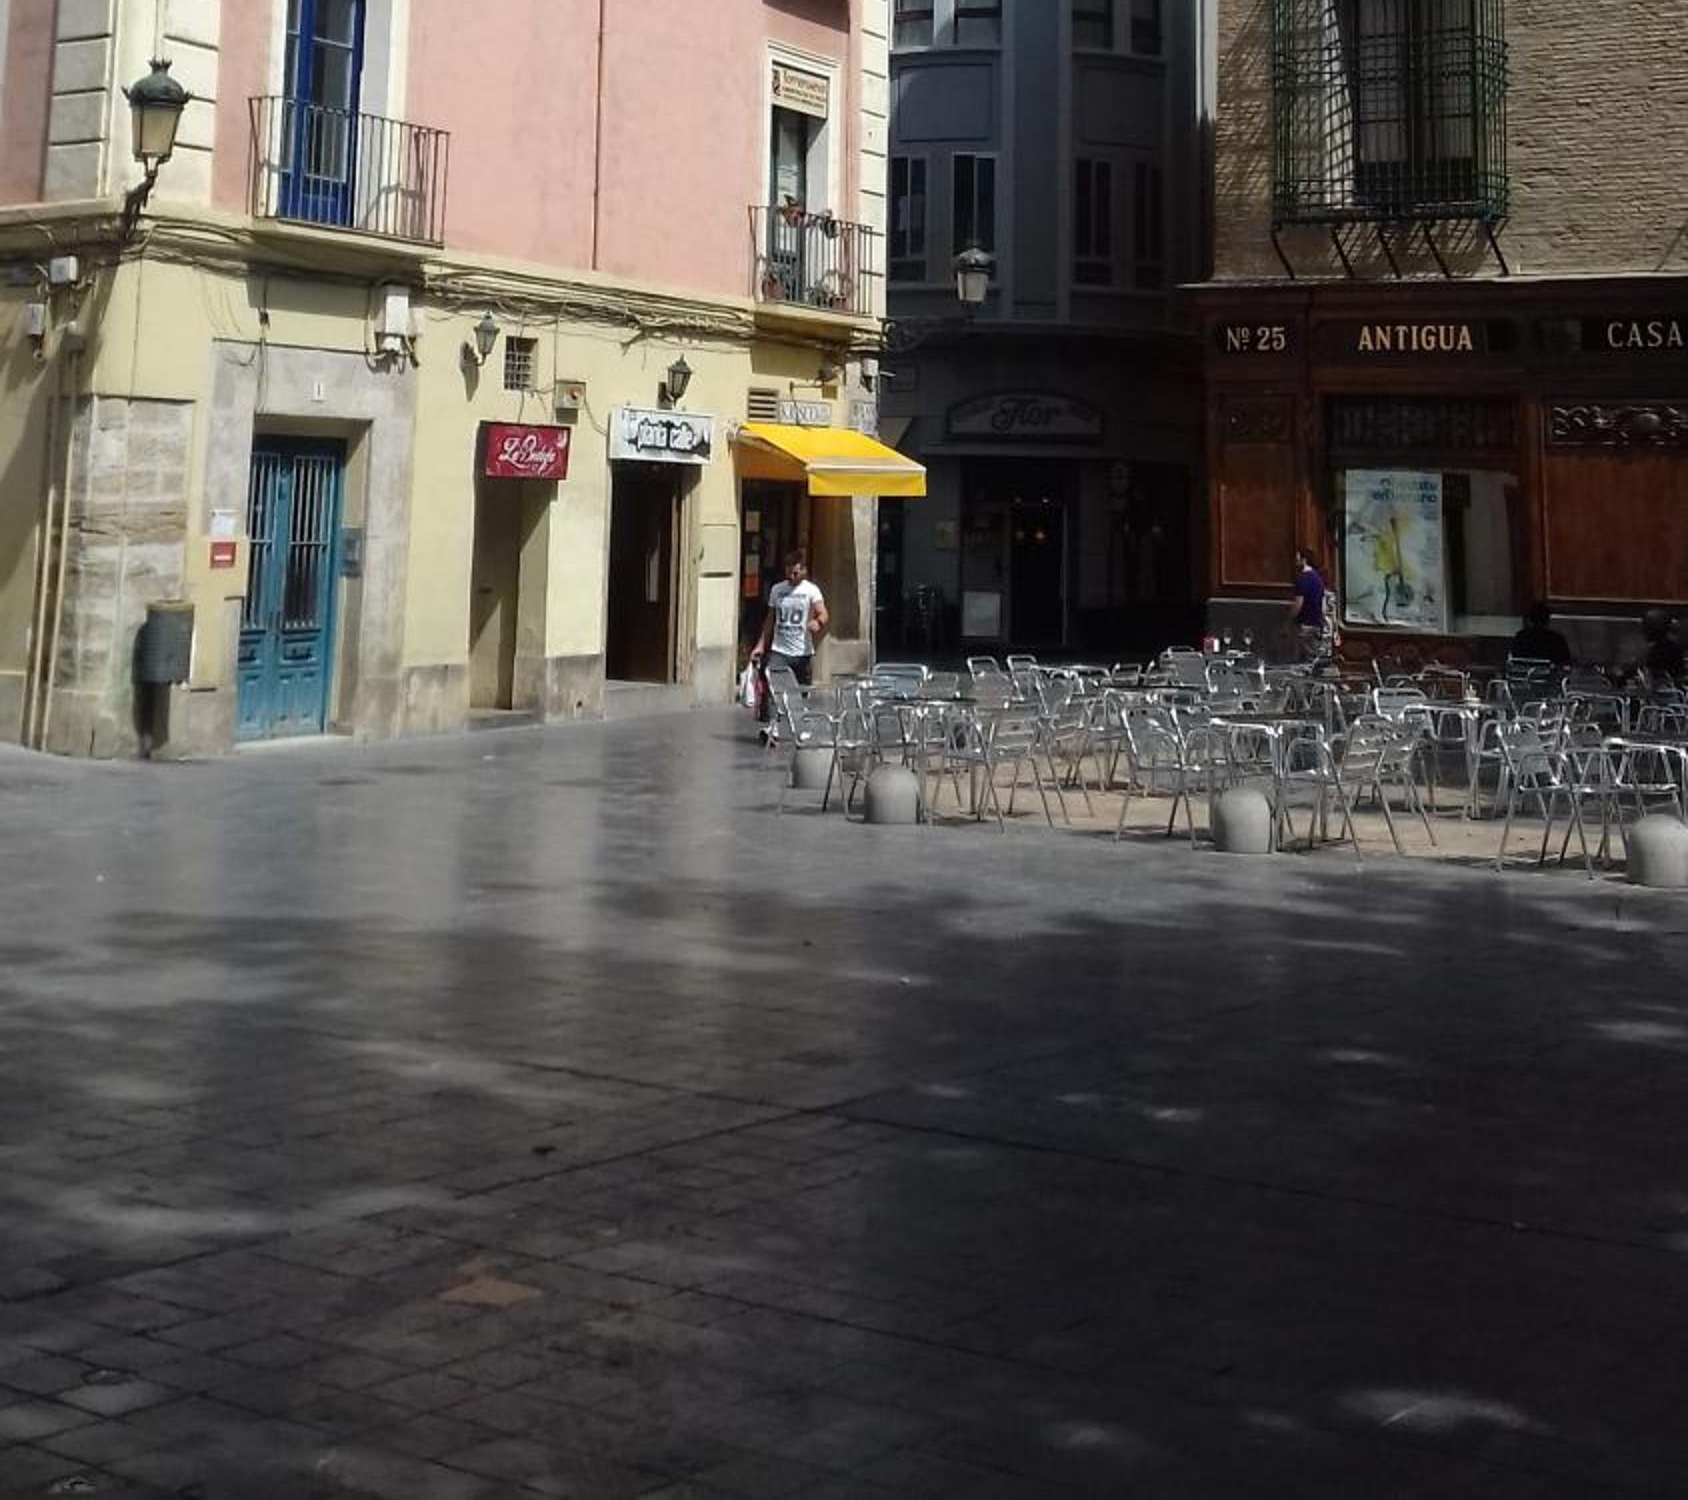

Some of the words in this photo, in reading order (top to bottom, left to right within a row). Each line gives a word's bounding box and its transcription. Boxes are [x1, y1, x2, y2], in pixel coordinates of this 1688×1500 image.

[1256, 327, 1286, 351] 25
[1357, 324, 1474, 351] ANTIGUA
[1607, 321, 1684, 349] CASA
